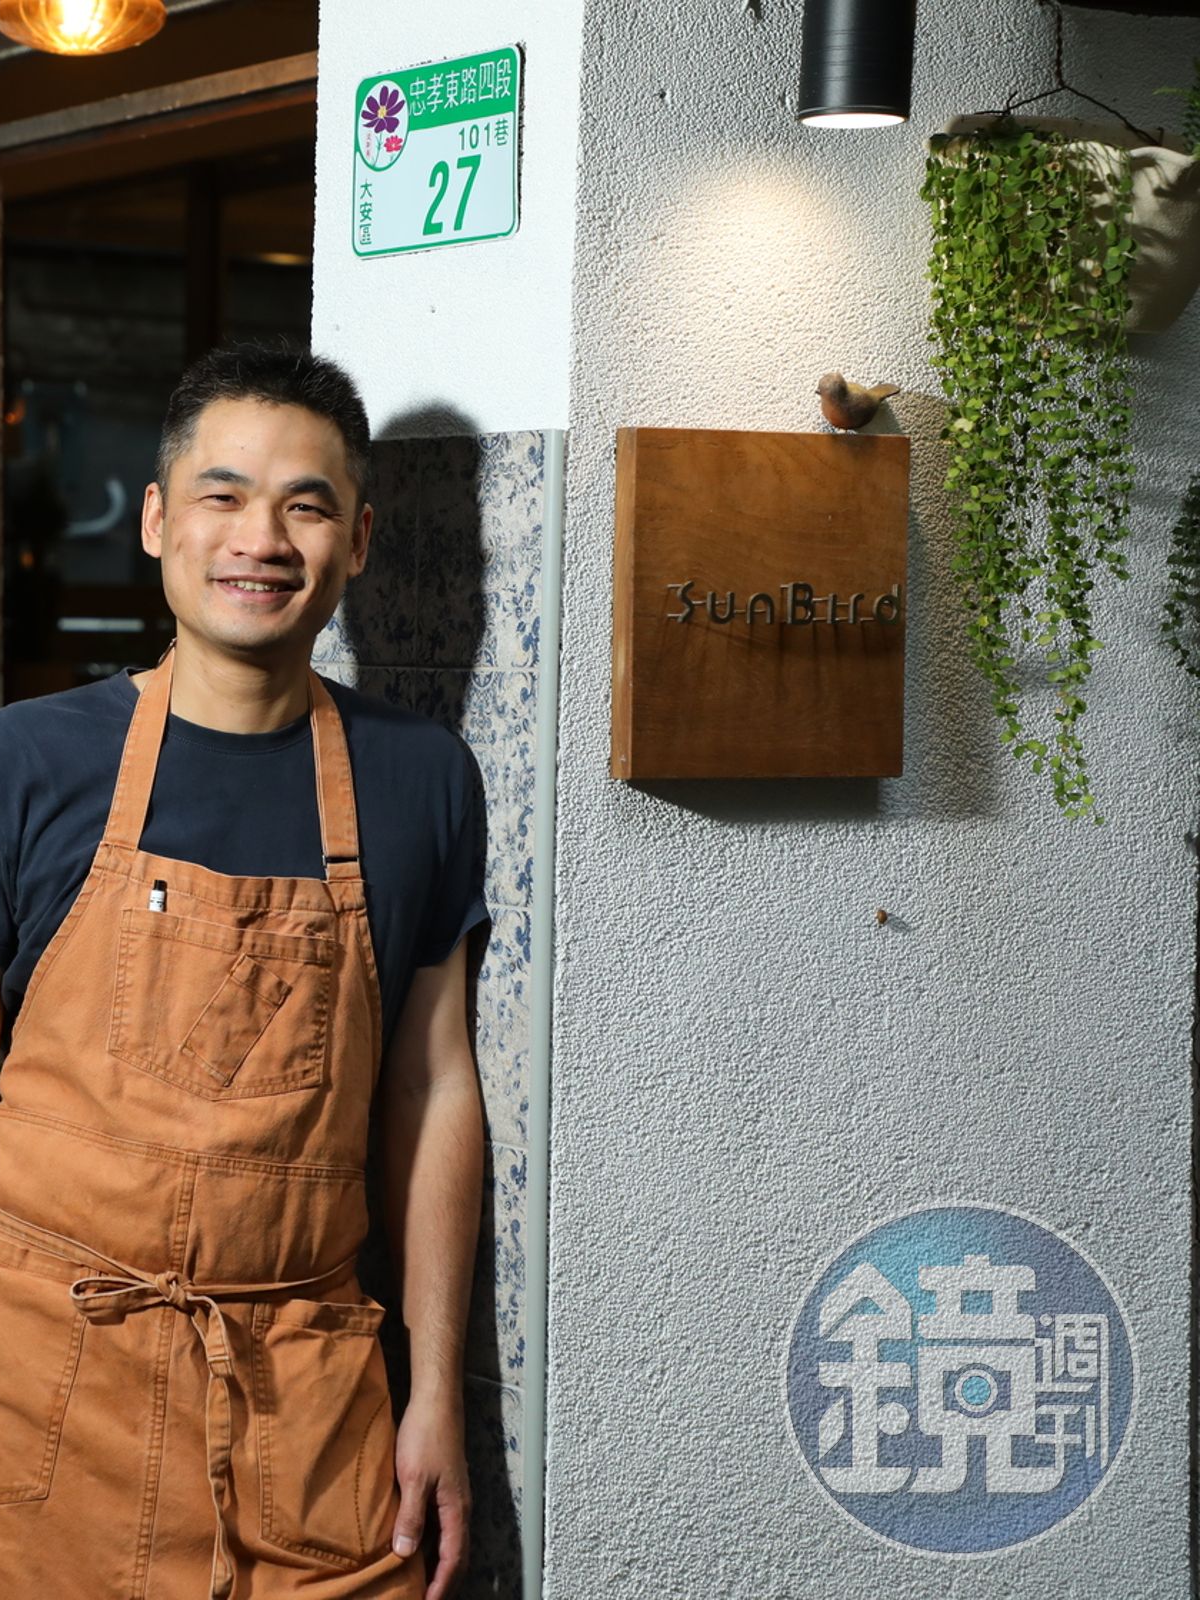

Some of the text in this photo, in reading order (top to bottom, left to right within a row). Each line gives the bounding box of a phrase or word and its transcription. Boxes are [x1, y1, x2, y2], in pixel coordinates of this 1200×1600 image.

[409, 58, 512, 117] 忠孝東路四段
[458, 118, 509, 151] 101巷
[360, 178, 373, 245] 大安區
[422, 153, 482, 236] 27
[675, 580, 901, 626] SunBird
